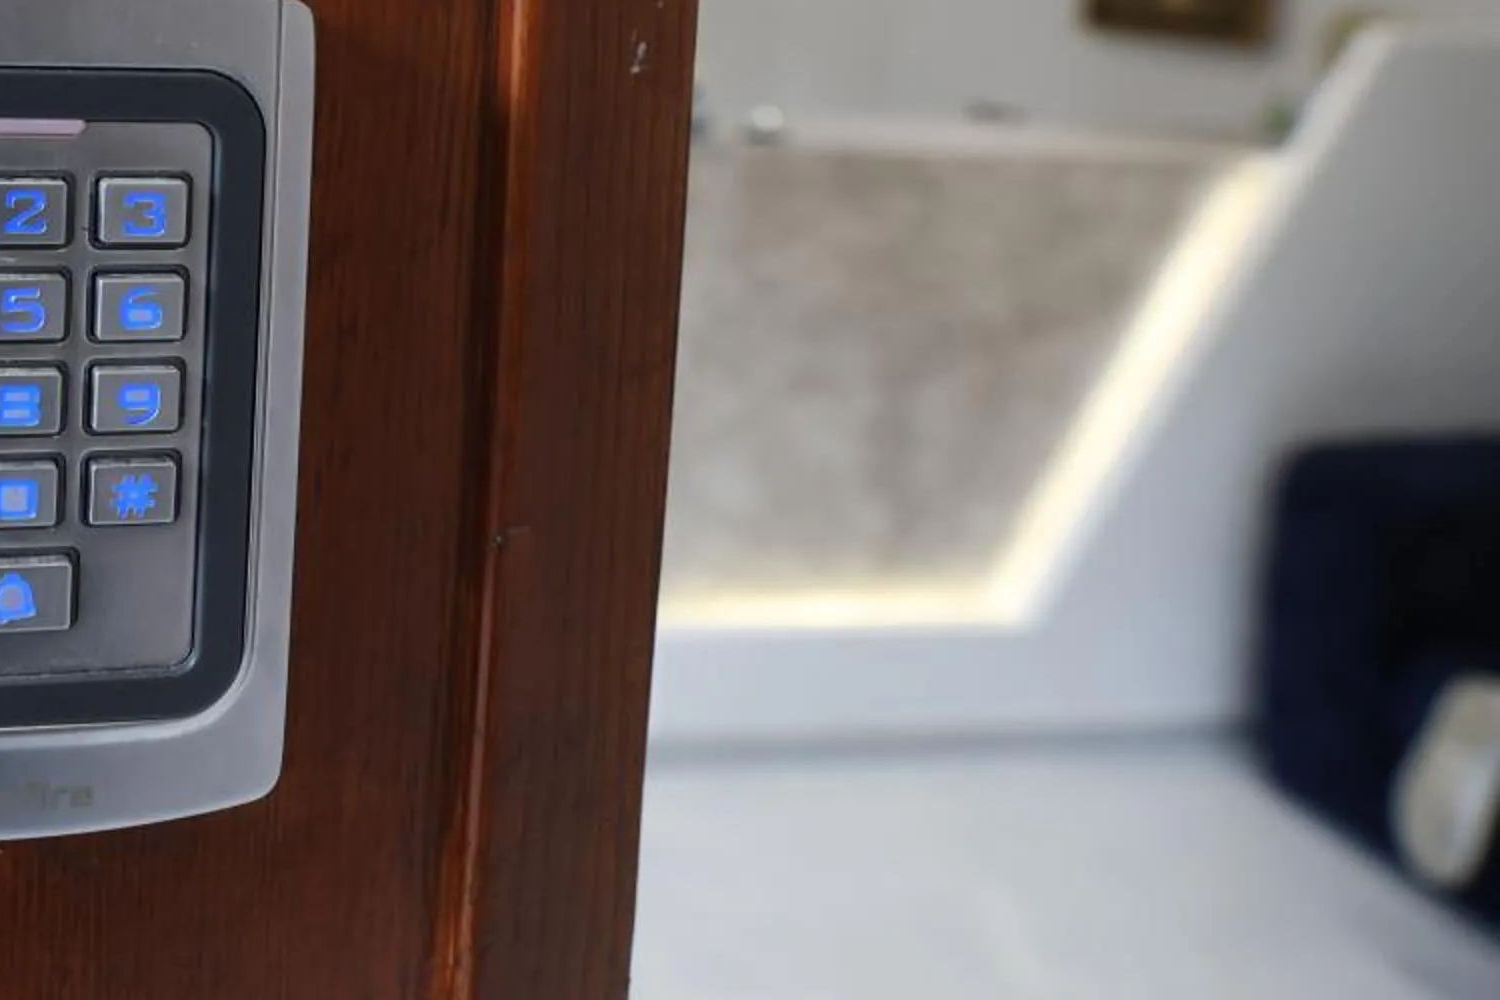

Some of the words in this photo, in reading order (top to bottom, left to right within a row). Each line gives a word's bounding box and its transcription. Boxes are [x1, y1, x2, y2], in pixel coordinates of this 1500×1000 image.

[3, 189, 49, 236] 2
[121, 190, 167, 237] 3
[1, 287, 46, 333] 5
[118, 286, 164, 332] 6
[116, 381, 162, 426] 9
